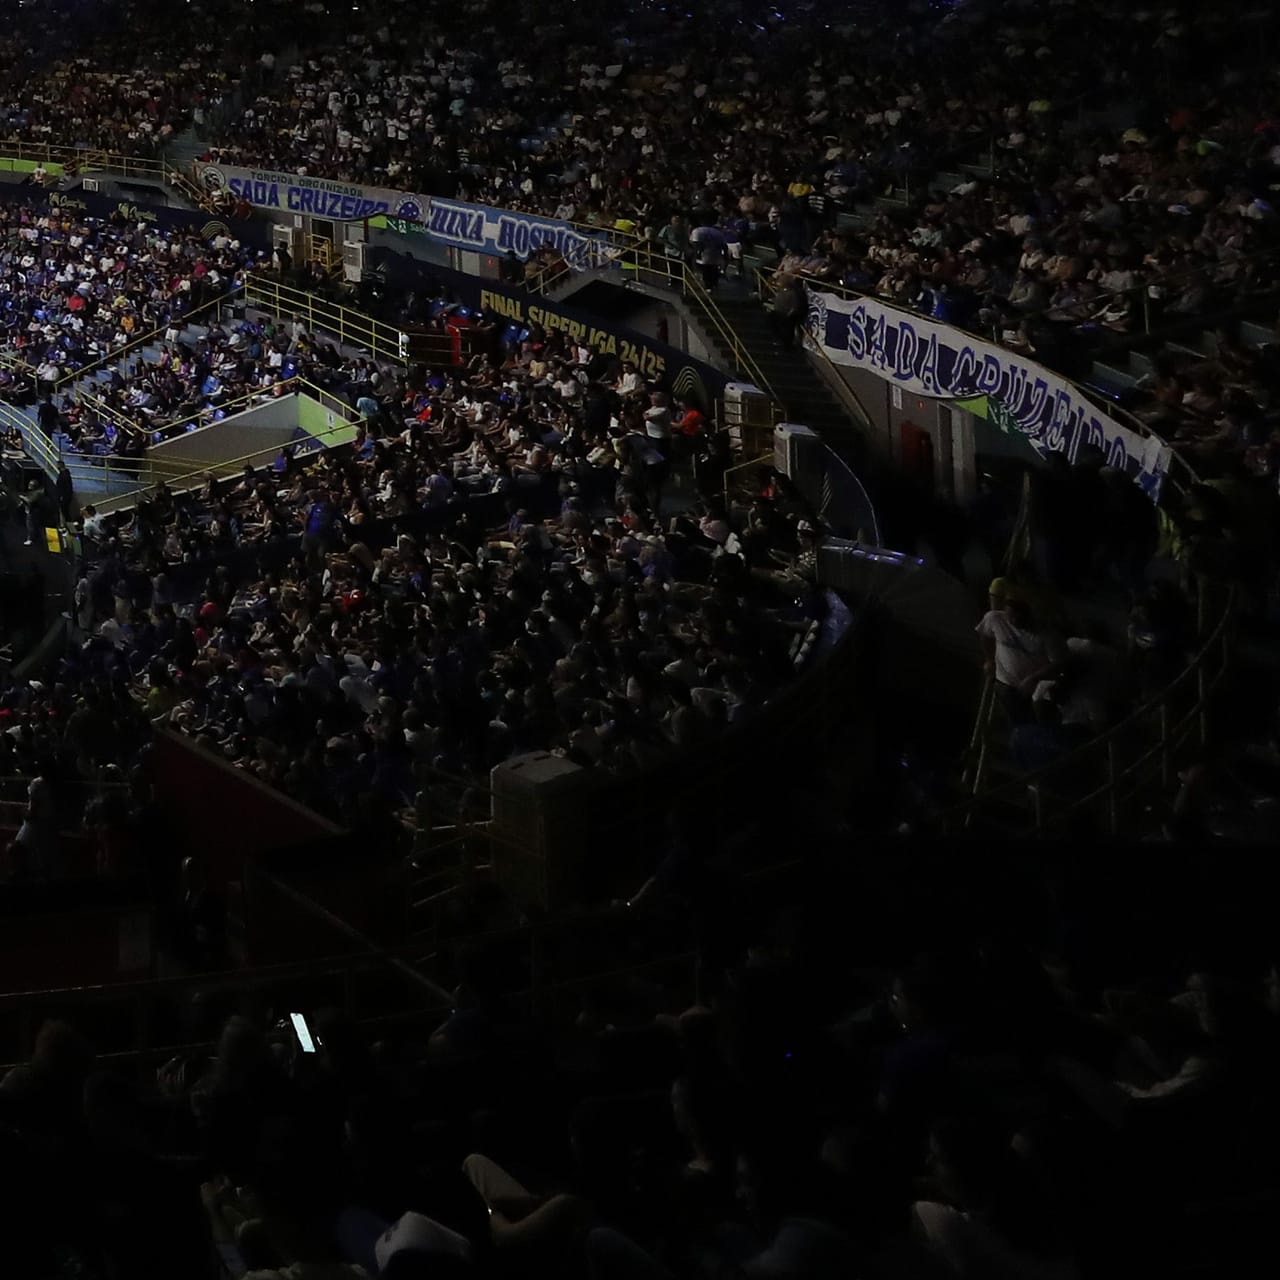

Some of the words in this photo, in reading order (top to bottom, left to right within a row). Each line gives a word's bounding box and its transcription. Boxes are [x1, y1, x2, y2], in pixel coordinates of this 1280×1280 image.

[229, 178, 280, 207] SADA
[287, 186, 390, 219] CRUZEIRO
[251, 171, 294, 186] TORCIDA
[299, 179, 364, 198] ORGANIZADA
[480, 288, 526, 322] FINAL
[528, 305, 617, 355] SUPERLIGA
[619, 338, 666, 376] 24/25
[848, 306, 941, 394] SADA
[950, 346, 1128, 468] CRUZEIRO
